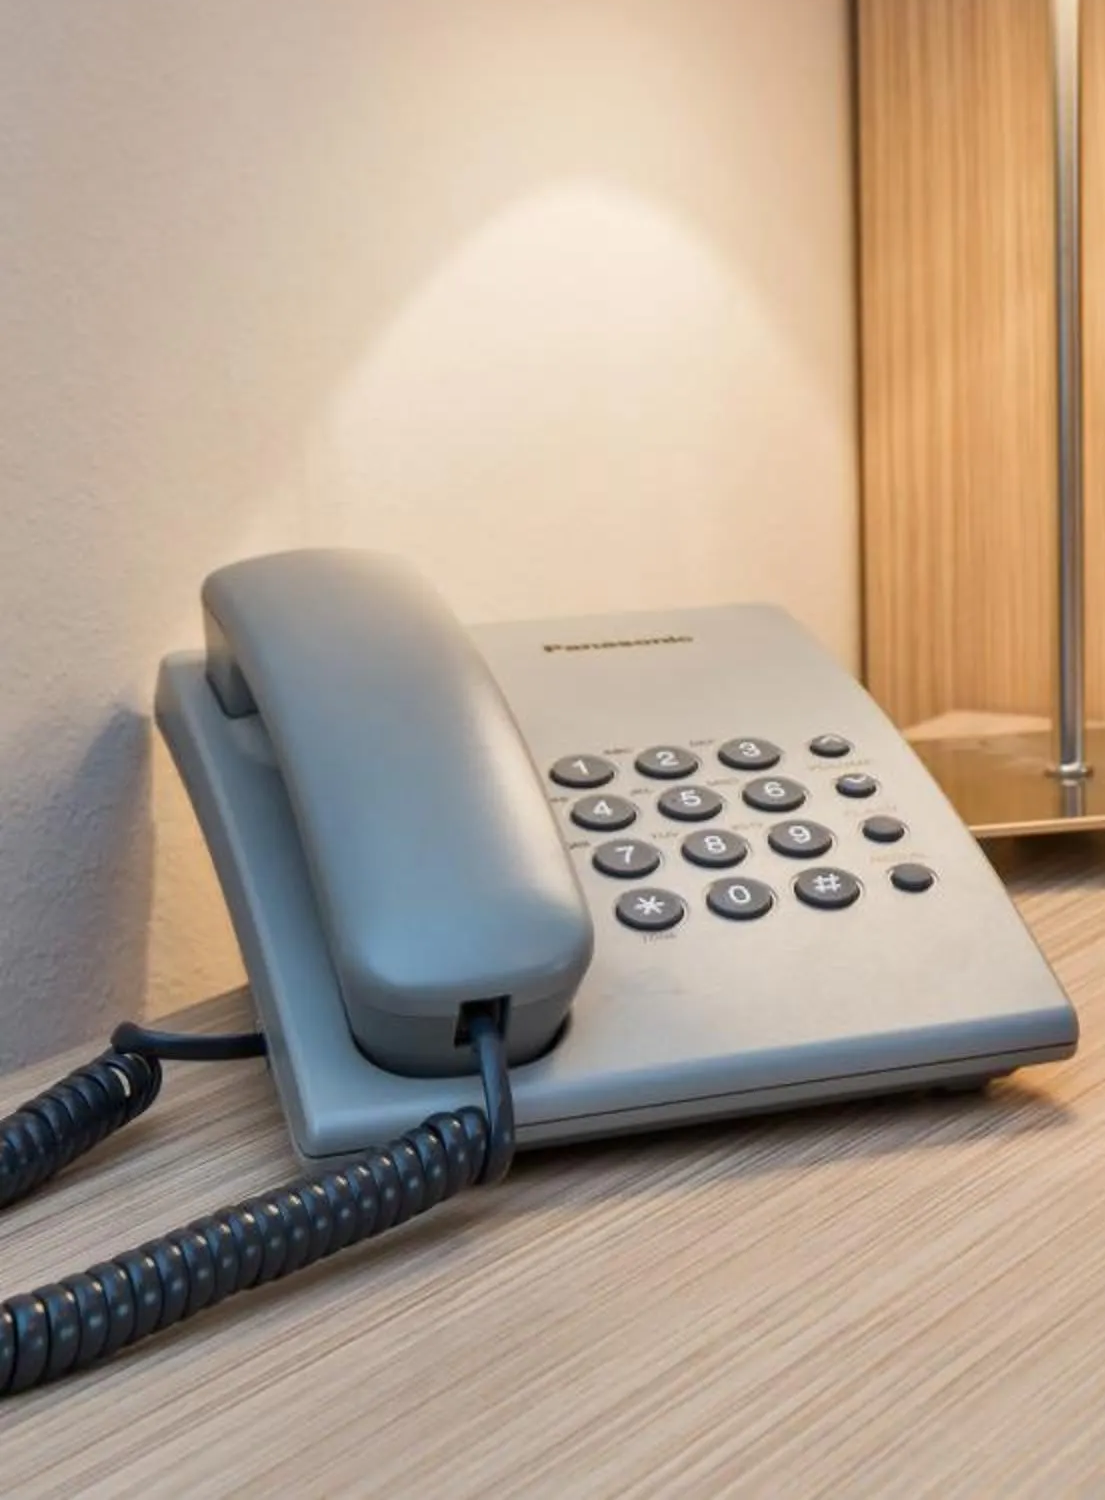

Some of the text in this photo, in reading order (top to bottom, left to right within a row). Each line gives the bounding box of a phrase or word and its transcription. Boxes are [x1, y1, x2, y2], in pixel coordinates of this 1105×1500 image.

[656, 750, 679, 767] 2
[738, 741, 761, 758] 3
[572, 759, 590, 776] 1
[679, 789, 701, 808] 5
[763, 781, 786, 798] 6
[593, 800, 613, 817] 4
[788, 825, 812, 844] 9
[704, 835, 726, 854] 8
[615, 845, 635, 864] 7
[728, 884, 751, 905] 0
